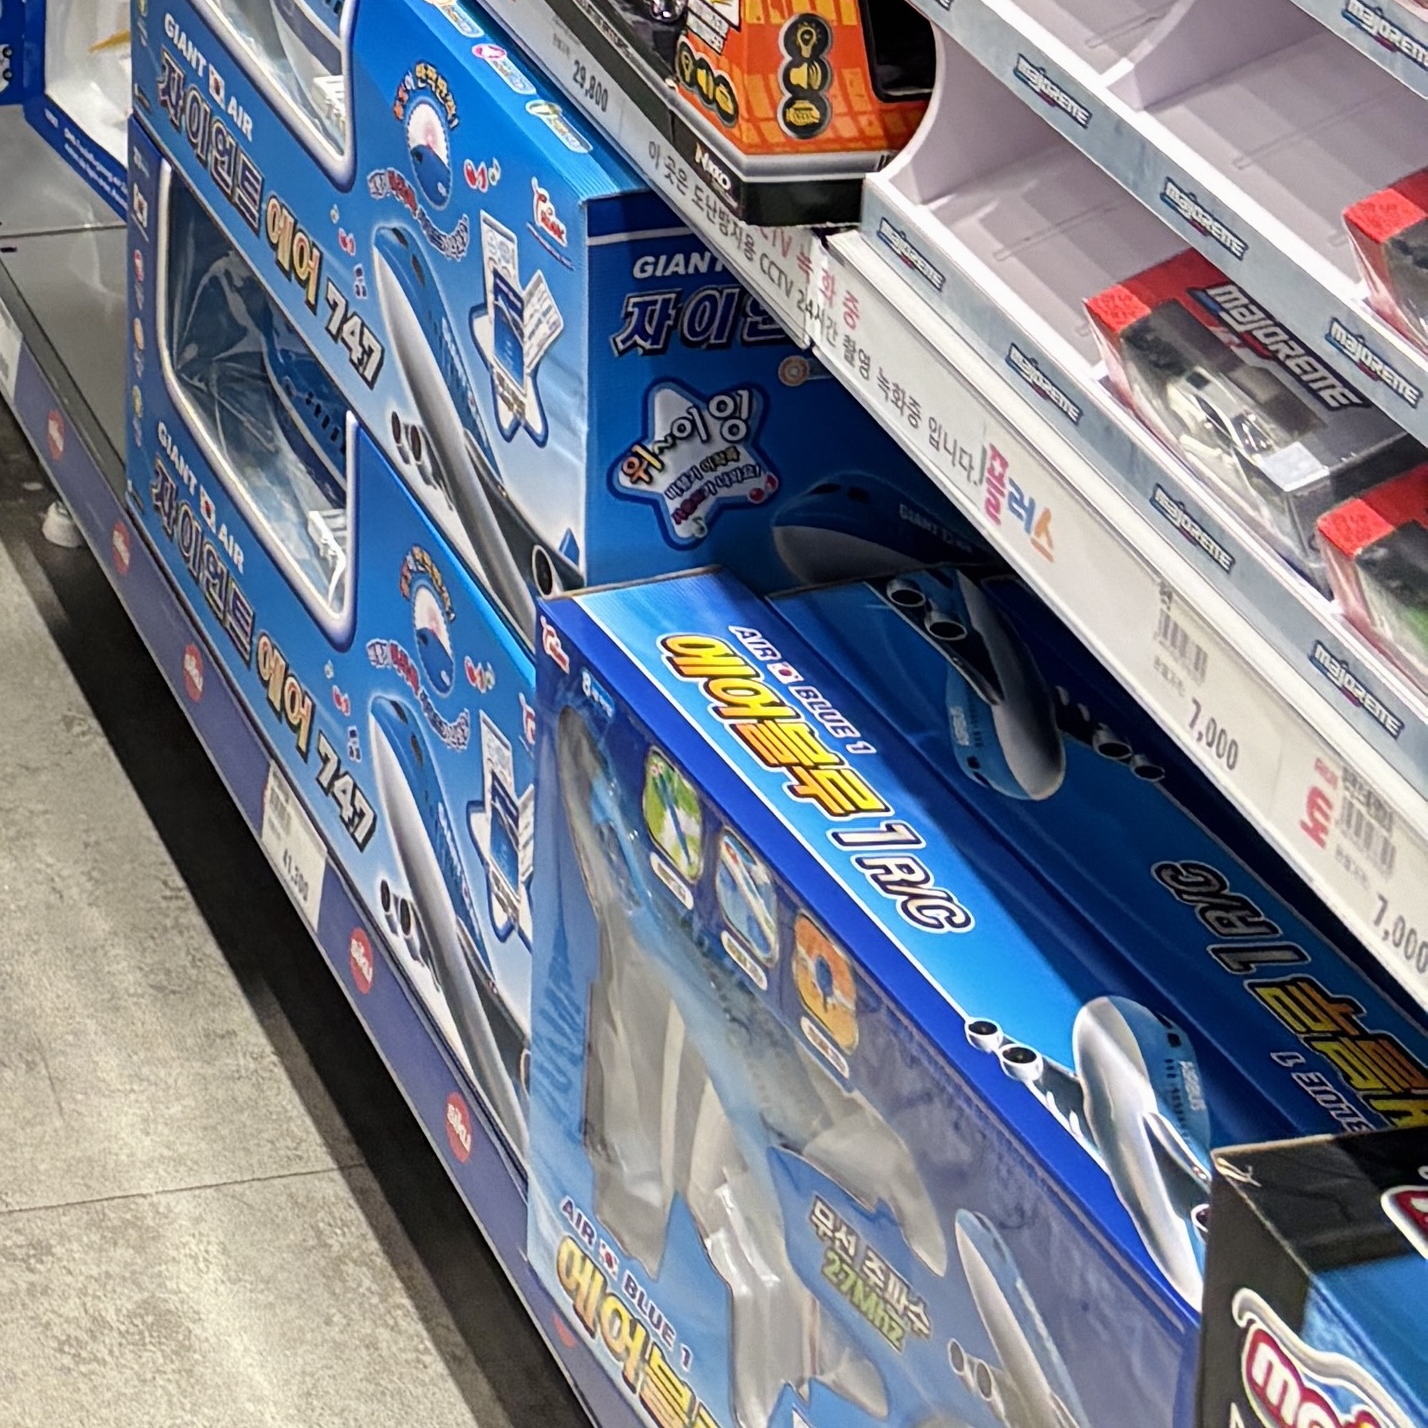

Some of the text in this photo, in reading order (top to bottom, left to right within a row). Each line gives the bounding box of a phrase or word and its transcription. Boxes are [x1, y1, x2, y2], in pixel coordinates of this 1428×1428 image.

[164, 12, 255, 142] GIANT AIR
[157, 48, 384, 389] 자이언트 에어 747
[759, 252, 795, 302] CCTV
[158, 422, 246, 573] GIANT AIR
[658, 634, 893, 818] 에어블루
[731, 627, 876, 755] AIR BLUE 1
[1187, 701, 1241, 772] 7,000
[317, 733, 376, 850] 747
[829, 821, 926, 850] 1
[853, 853, 975, 934] R/C
[1372, 893, 1428, 974] 7,000
[561, 1195, 693, 1372] AIR BLUE 1
